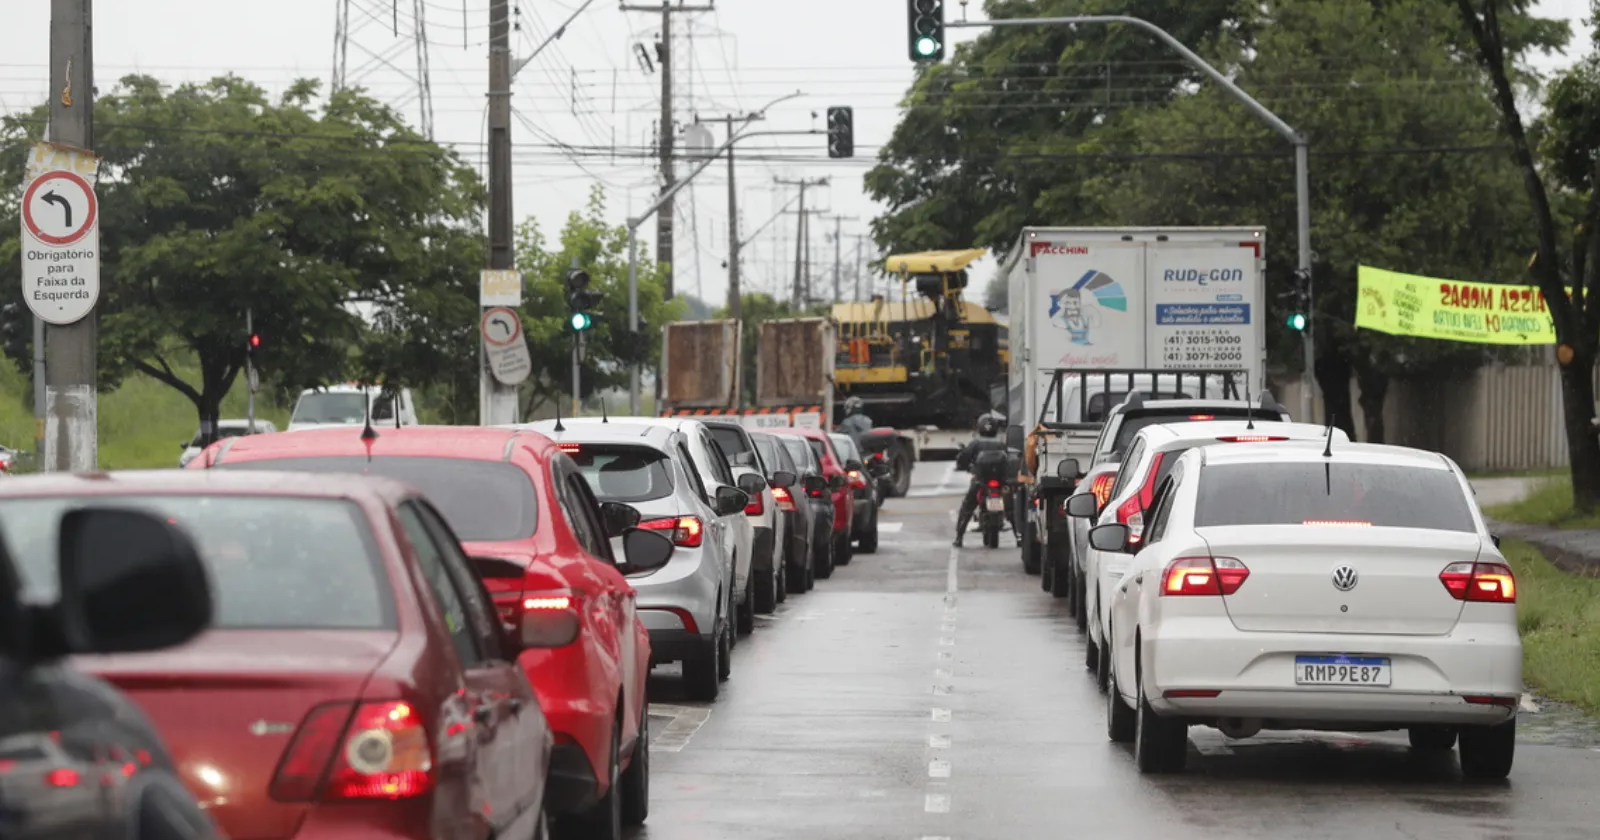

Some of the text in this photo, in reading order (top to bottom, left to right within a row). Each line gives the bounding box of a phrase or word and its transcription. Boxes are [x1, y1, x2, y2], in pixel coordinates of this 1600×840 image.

[27, 249, 94, 262] Obrigatório
[47, 264, 74, 275] para
[37, 276, 85, 287] Faixa da
[1164, 268, 1243, 286] RUDEGON
[33, 289, 90, 302] Esquerda
[1164, 335, 1241, 346] (41) 3015-1000
[1164, 352, 1243, 362] (41) 3071-2000
[1304, 665, 1382, 682] RMP9E87
